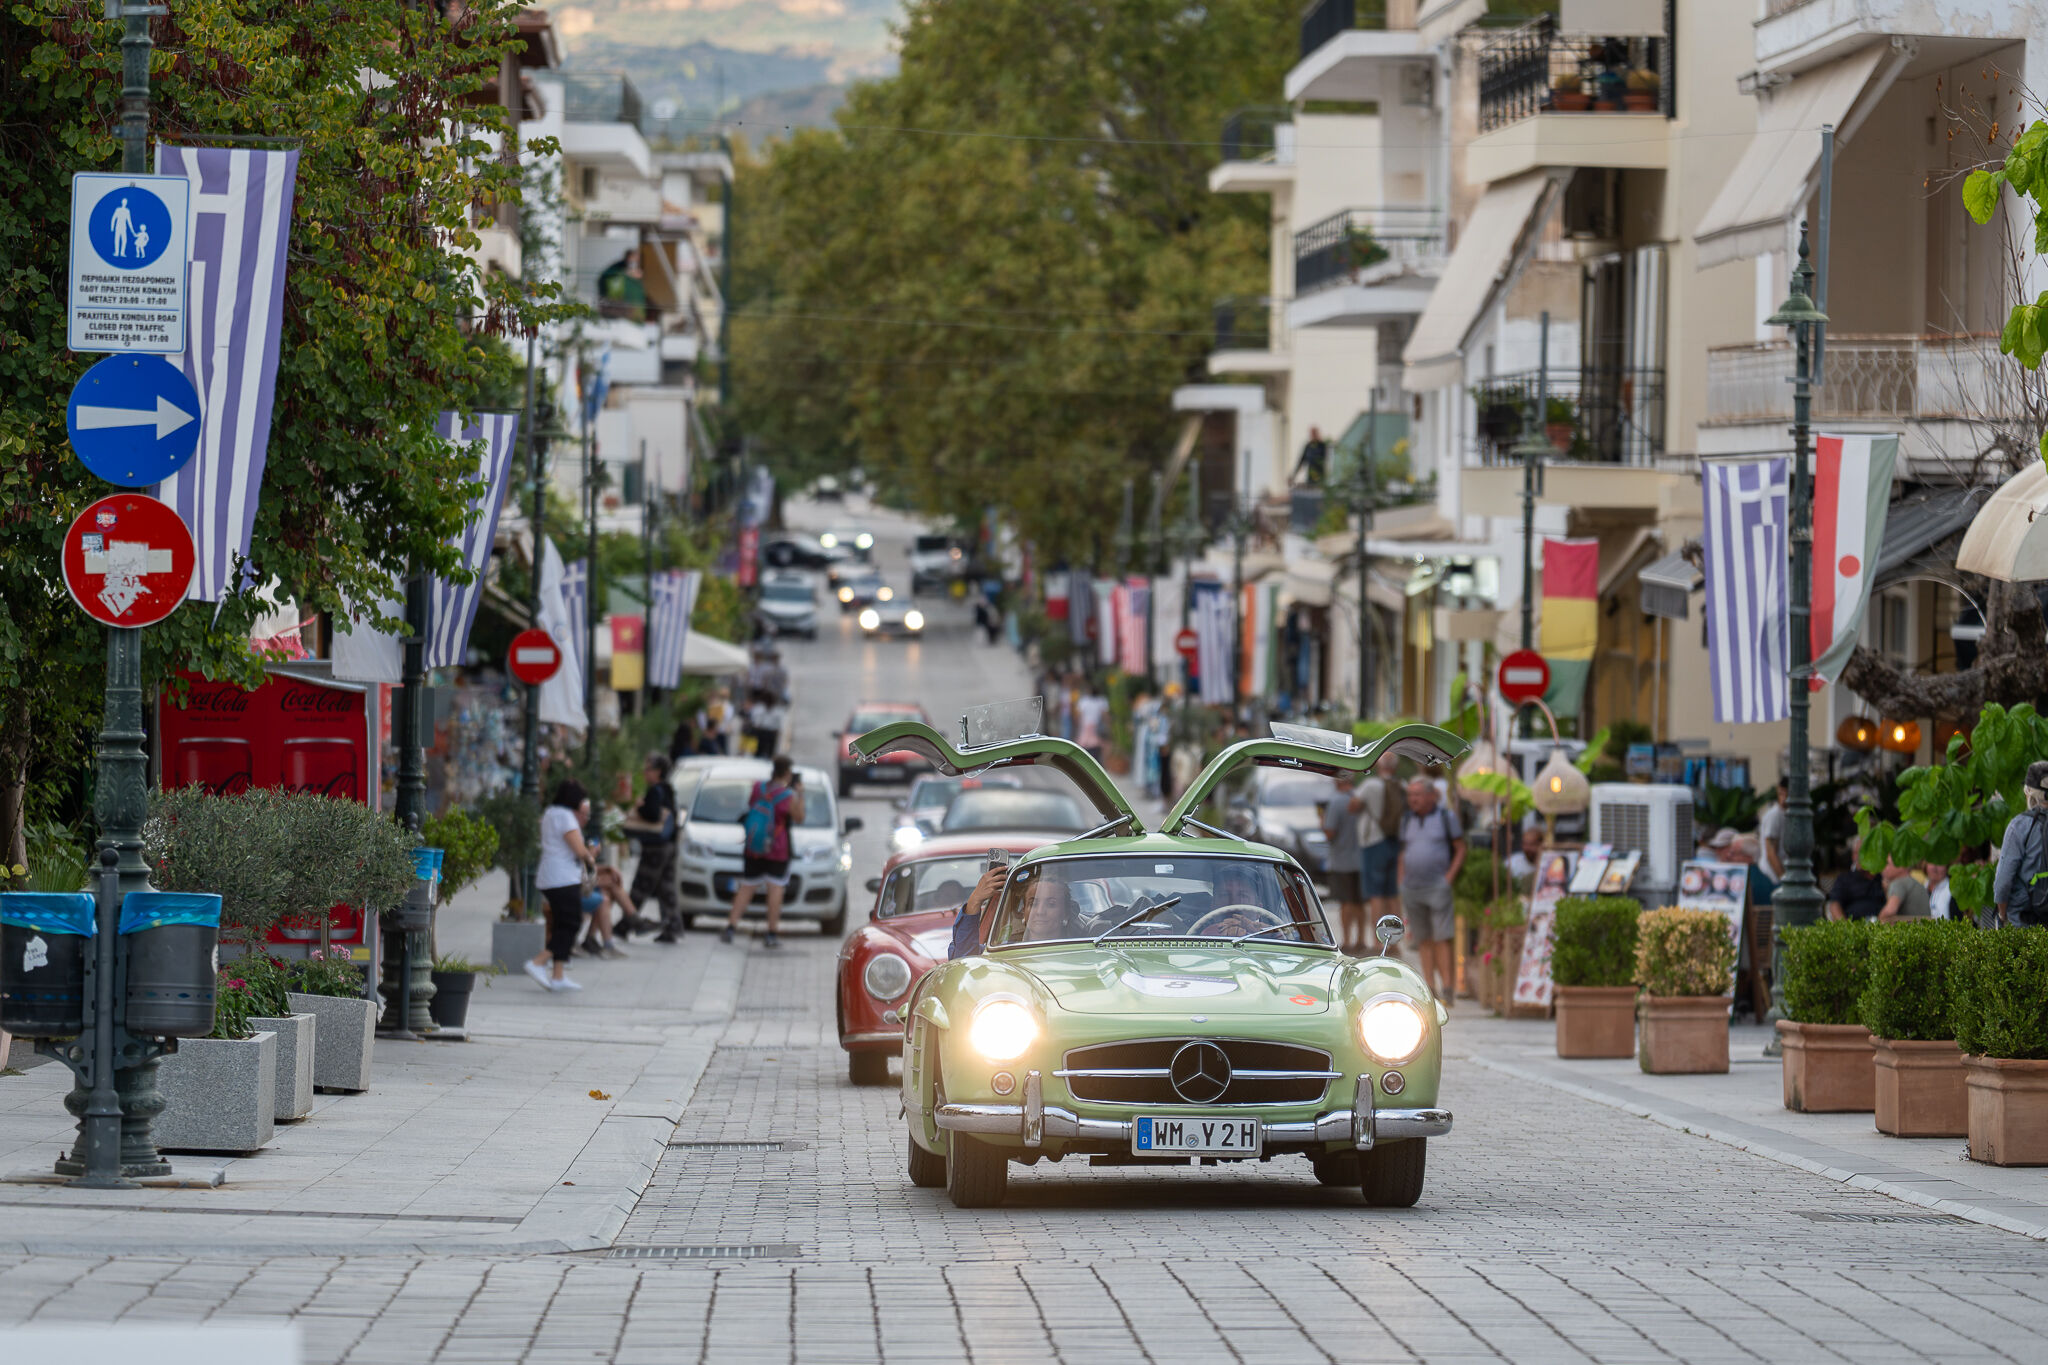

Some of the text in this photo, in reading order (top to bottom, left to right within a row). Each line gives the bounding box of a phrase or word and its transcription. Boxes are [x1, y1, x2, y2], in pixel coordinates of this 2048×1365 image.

[81, 274, 175, 284] ΠΕΡΙΟΔΙΚΗ ΠΕΖΟΔΡΟΜΗΣΗ
[79, 285, 177, 295] ΟΔΟΥ ΠΡΑΞΙΤΕΛΗ ΚΟΝΔΥΛΗ
[88, 296, 117, 304] ΜΕΤΑΞΥ
[77, 312, 177, 323] PRAXITELIS KONDILIS ROAD
[89, 322, 165, 333] CLOSED FOR TRAFFIC
[84, 333, 119, 341] BETWEEN
[1164, 981, 1191, 989] 8
[1289, 994, 1318, 1006] 8
[1154, 1121, 1183, 1146] WM
[1141, 1136, 1148, 1144] D
